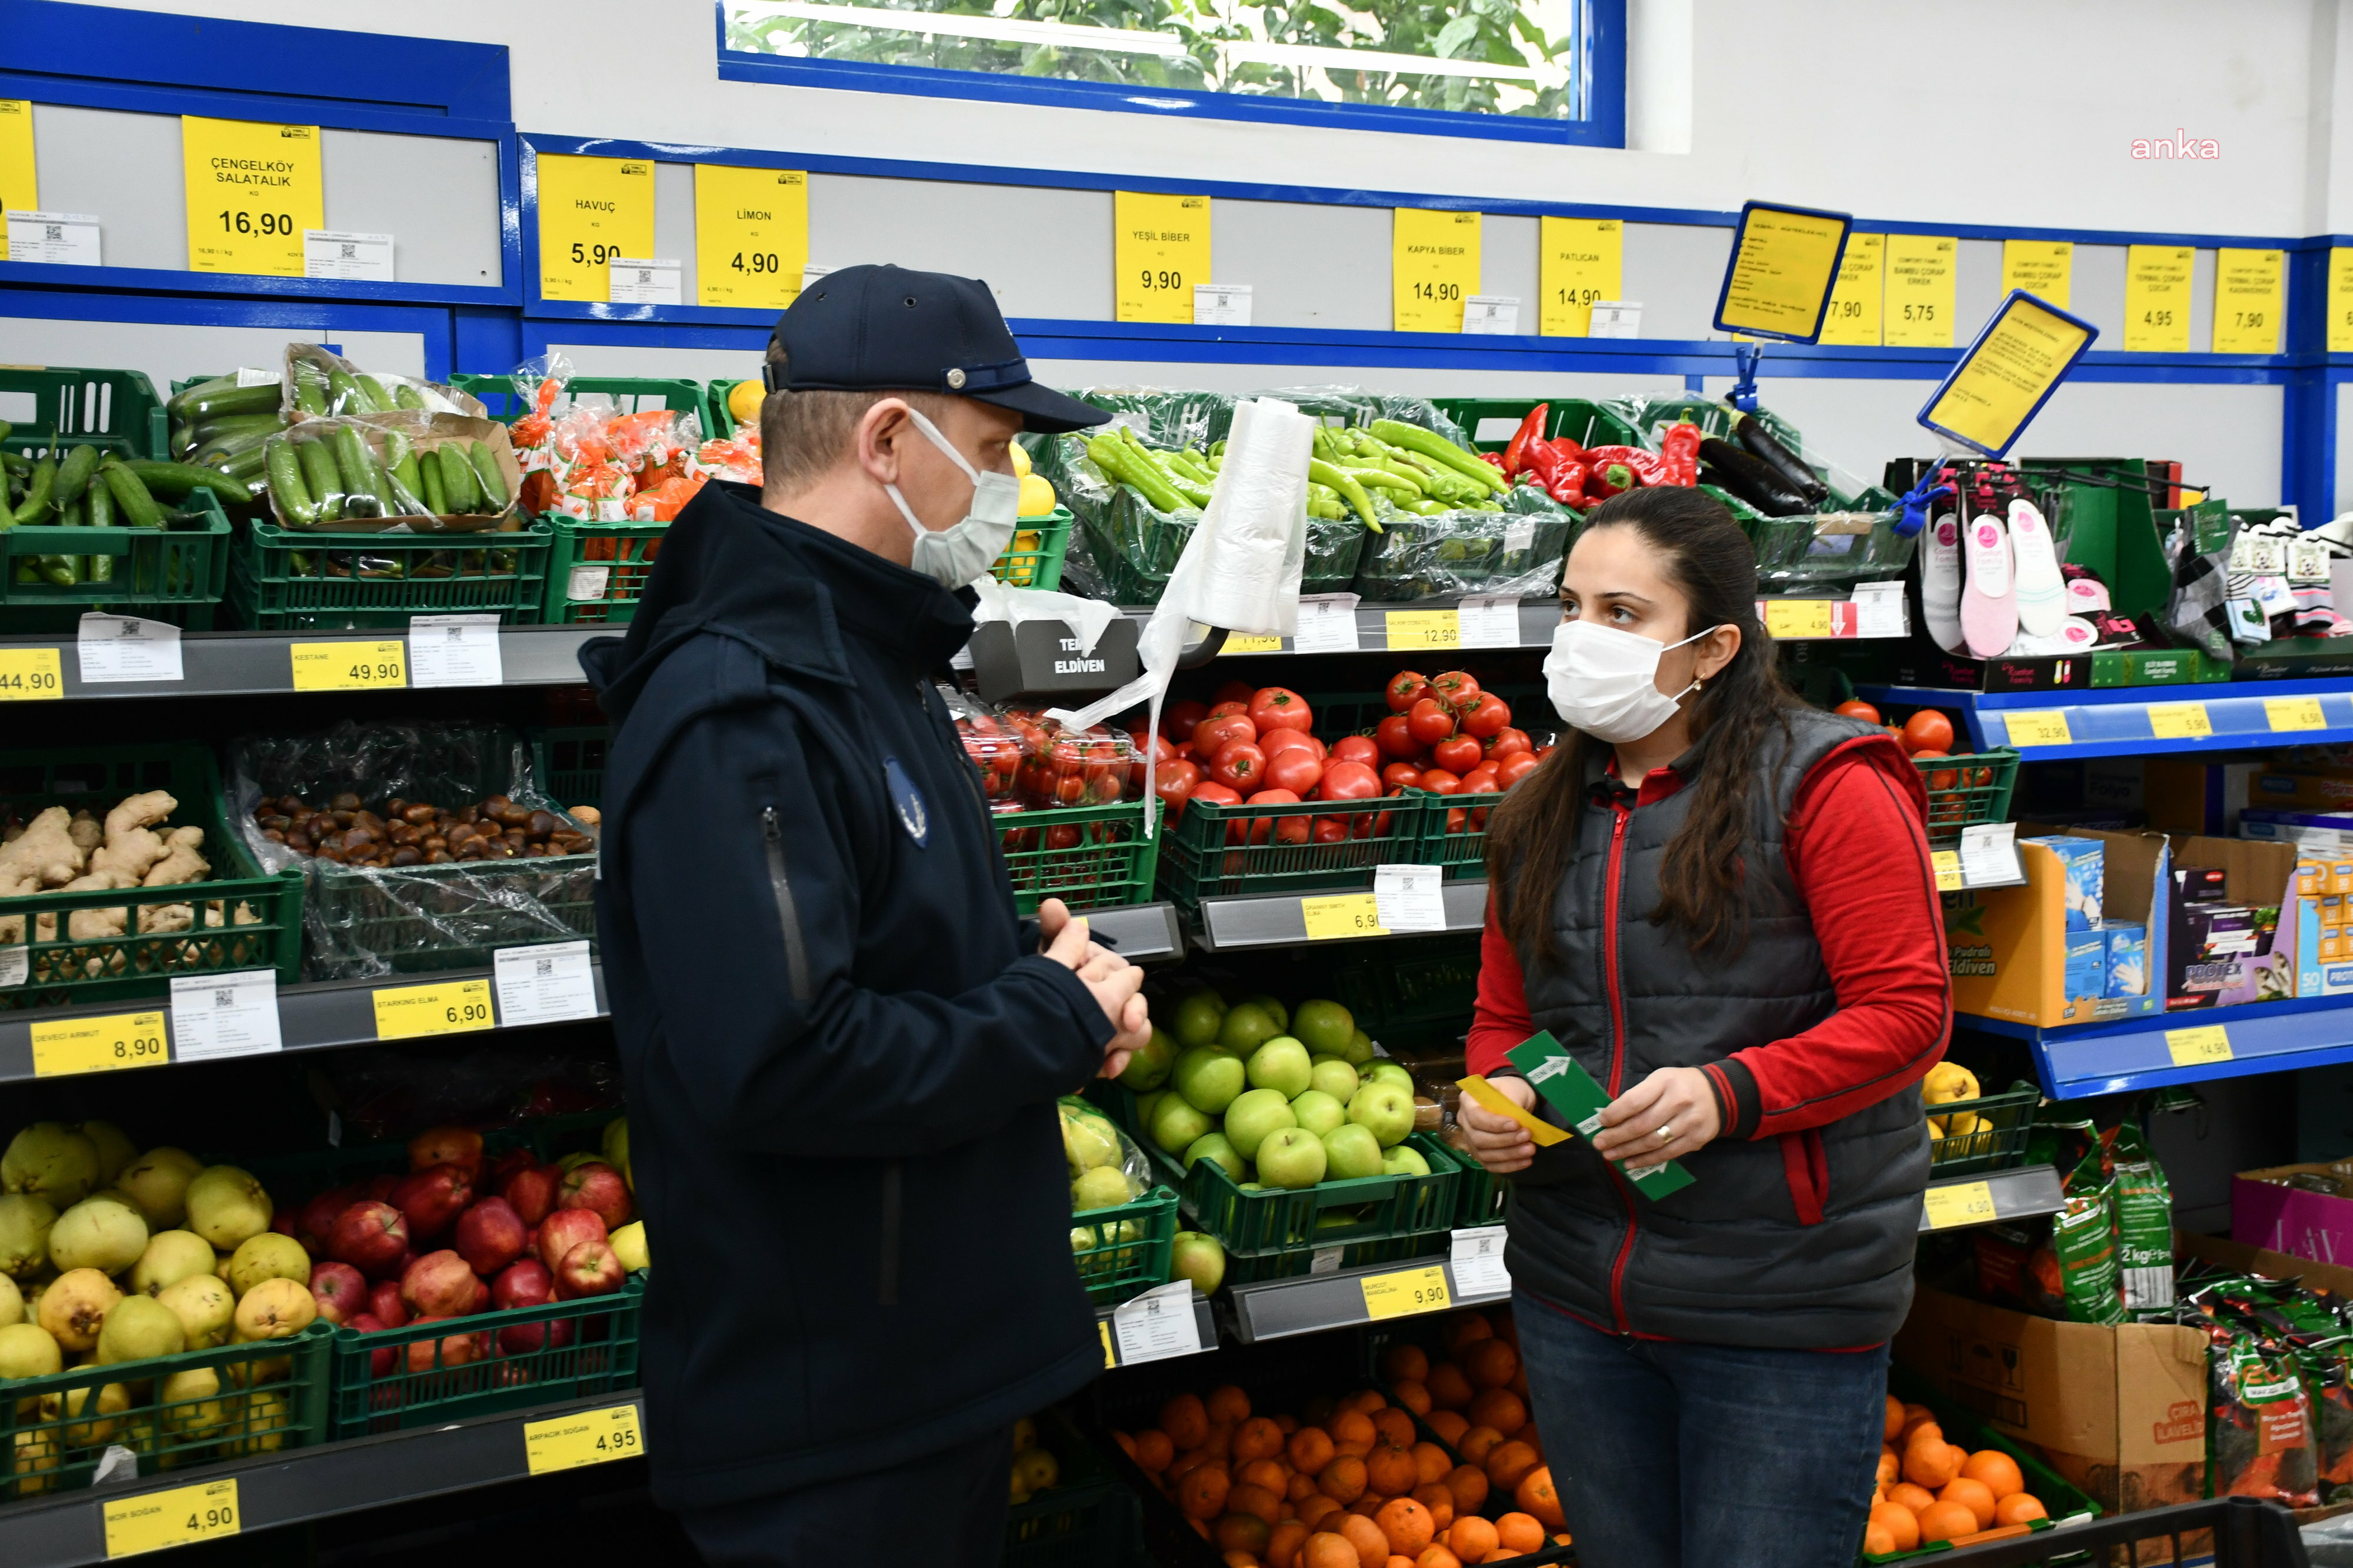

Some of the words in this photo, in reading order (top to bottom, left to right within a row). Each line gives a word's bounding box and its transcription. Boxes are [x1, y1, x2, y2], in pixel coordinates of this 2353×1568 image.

[211, 158, 294, 172] ÇENGELKÖY
[216, 172, 291, 186] SALATALIK
[576, 199, 615, 213] HAVUÇ
[737, 208, 771, 220] LİMON
[219, 211, 292, 238] 16,90
[1132, 231, 1158, 242] YEŞİL
[1161, 231, 1189, 242] BİBER
[571, 243, 620, 268] 5,90
[1439, 246, 1465, 255] BİBER
[1560, 253, 1599, 262] PATLICAN
[731, 252, 778, 276] 4,90
[1142, 270, 1181, 292] 9,90
[1414, 282, 1459, 303] 14,90
[1558, 289, 1601, 308] 14,90
[1831, 301, 1861, 319] 7,90
[1904, 305, 1934, 323] 5,75
[2144, 311, 2172, 328] 4,95
[2237, 312, 2263, 328] 7,90
[349, 663, 399, 682] 49,90
[1054, 657, 1105, 673] ELDİVEN
[0, 673, 55, 692] 44,90
[2185, 962, 2242, 979] PROTEX
[2302, 972, 2320, 987] 50
[377, 997, 416, 1009] STARKING
[418, 996, 439, 1004] ELMA
[446, 1004, 486, 1024] 6,90
[35, 1032, 68, 1043] DEVECİ
[69, 1029, 100, 1039] ARMUT
[114, 1037, 159, 1060] 8,90
[1415, 1286, 1444, 1305] 9,90
[596, 1430, 635, 1452] 4,95
[107, 1513, 127, 1522] MOR
[130, 1505, 162, 1518] SOĞAN
[186, 1507, 232, 1532] 4,90
